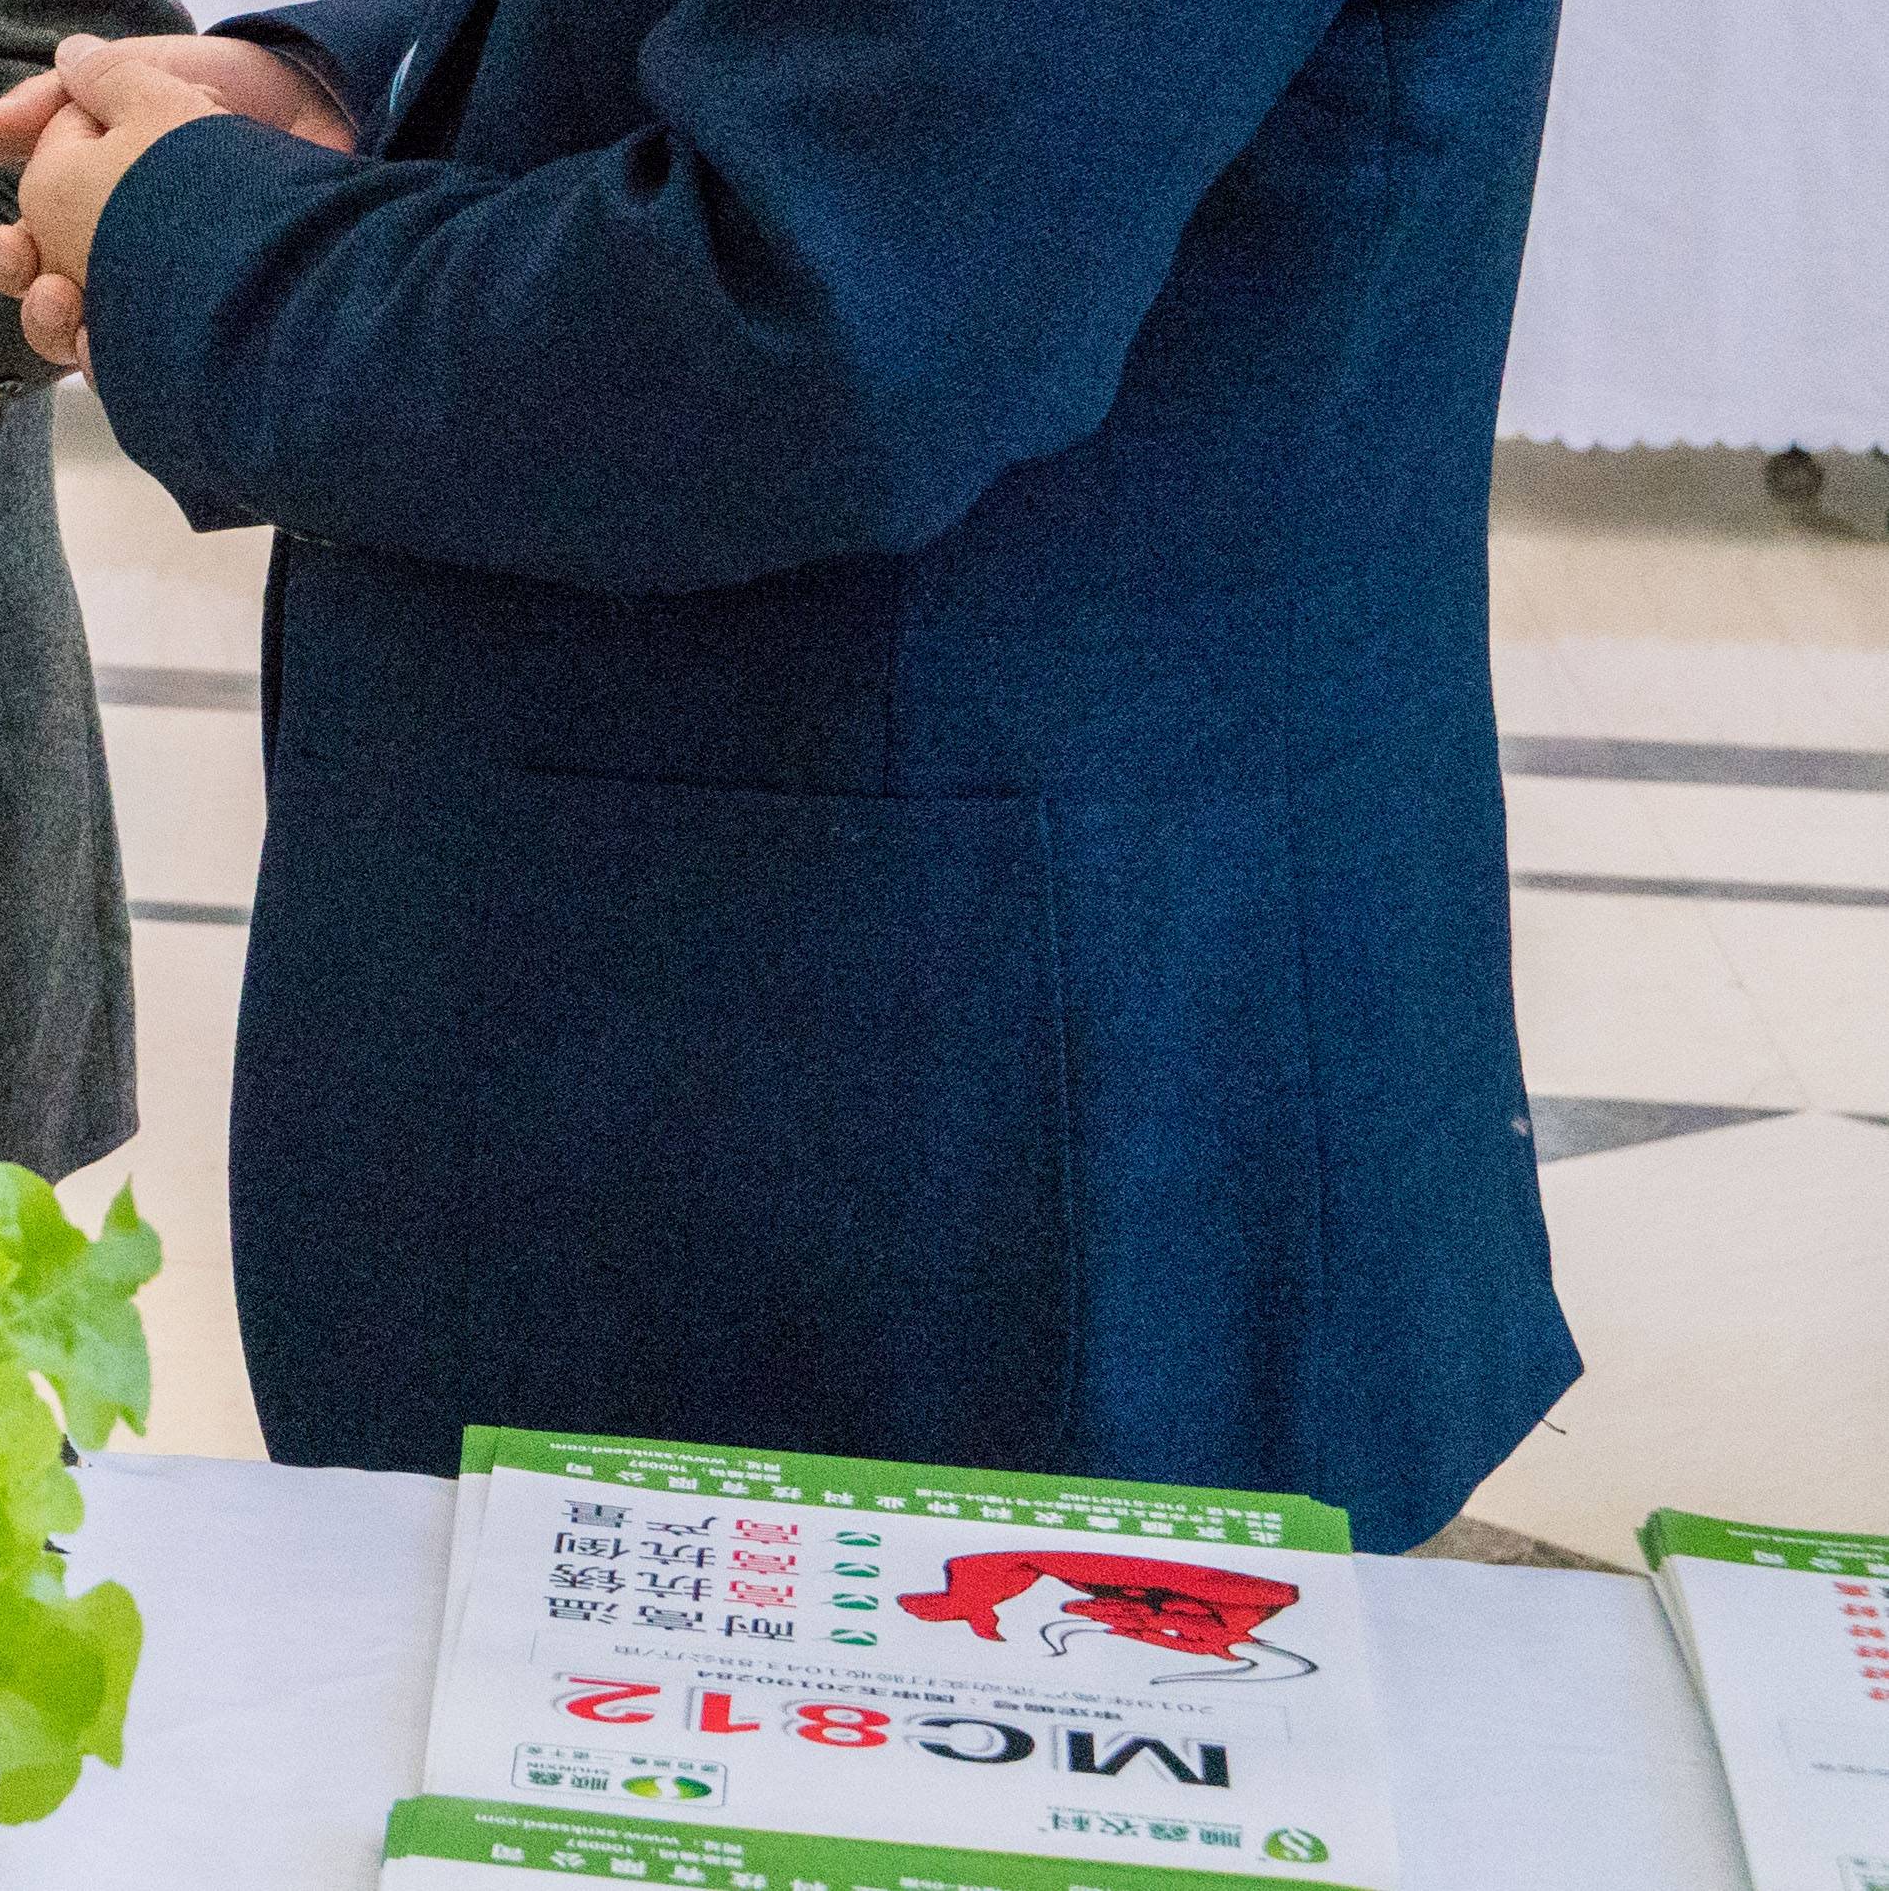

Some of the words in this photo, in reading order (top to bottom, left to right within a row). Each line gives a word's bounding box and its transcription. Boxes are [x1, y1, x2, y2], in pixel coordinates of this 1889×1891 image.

[562, 1499, 802, 1547] 高产量
[553, 1531, 800, 1576] 高抗倒
[549, 1563, 798, 1609] 高抗锈
[543, 1595, 796, 1643] 耐高温
[566, 1675, 1230, 1789] MC812
[1051, 1811, 1242, 1849] 顺鑫农科
